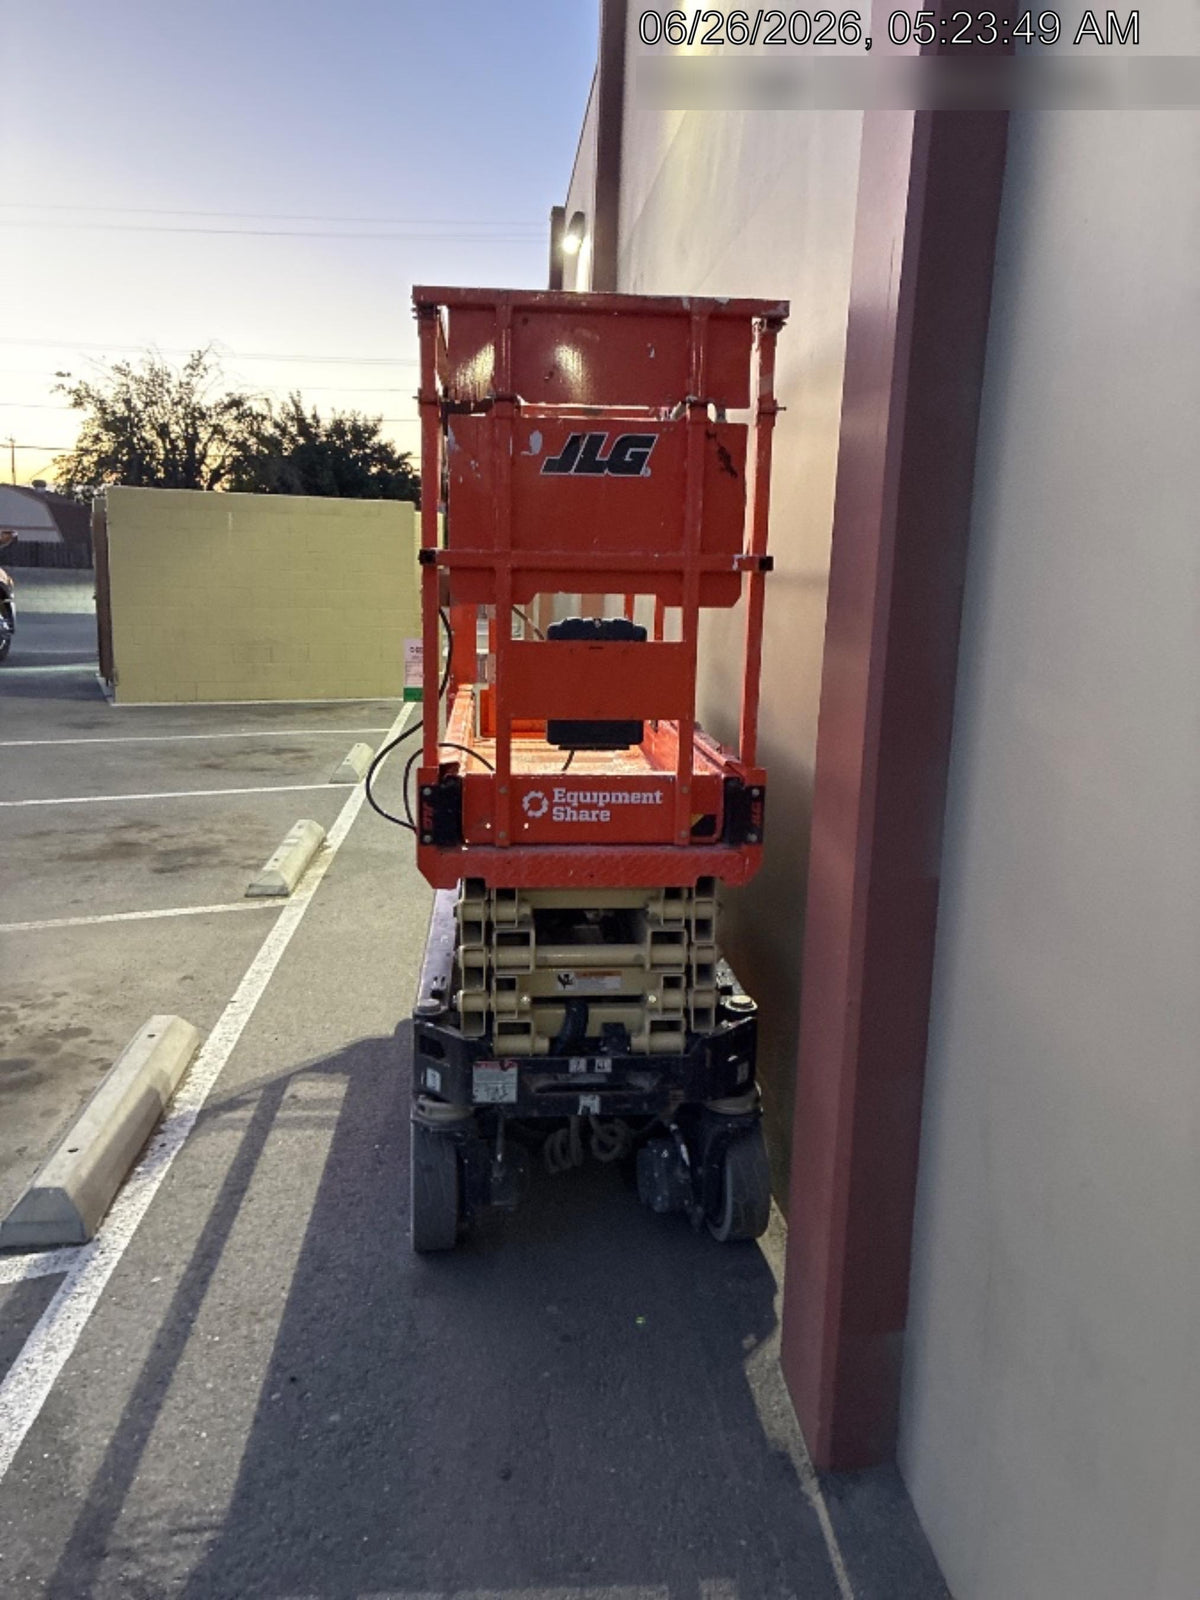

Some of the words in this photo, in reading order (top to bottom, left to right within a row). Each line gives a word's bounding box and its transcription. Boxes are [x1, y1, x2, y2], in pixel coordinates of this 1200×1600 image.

[540, 432, 659, 477] JLG
[552, 787, 663, 807] Equipment
[552, 806, 611, 822] Share
